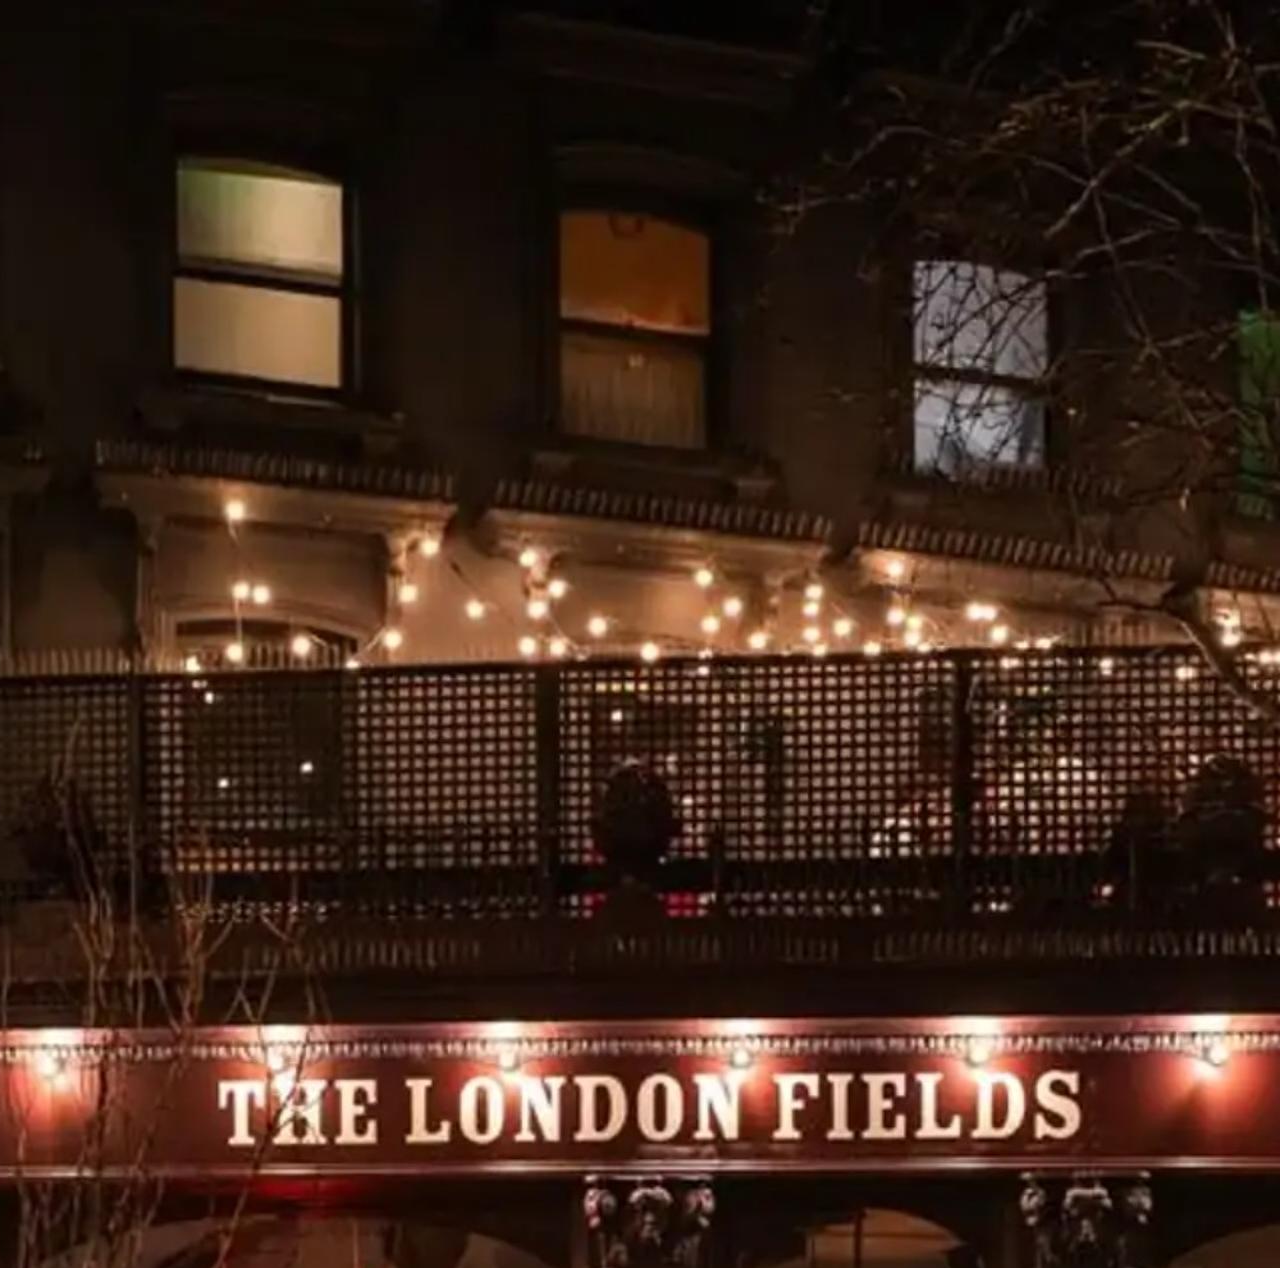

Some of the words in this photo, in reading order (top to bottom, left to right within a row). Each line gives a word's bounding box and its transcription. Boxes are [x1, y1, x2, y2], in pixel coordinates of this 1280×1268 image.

[218, 1079, 377, 1145] THE
[406, 1074, 741, 1143] LONDON
[772, 1070, 1081, 1140] FIELDS
